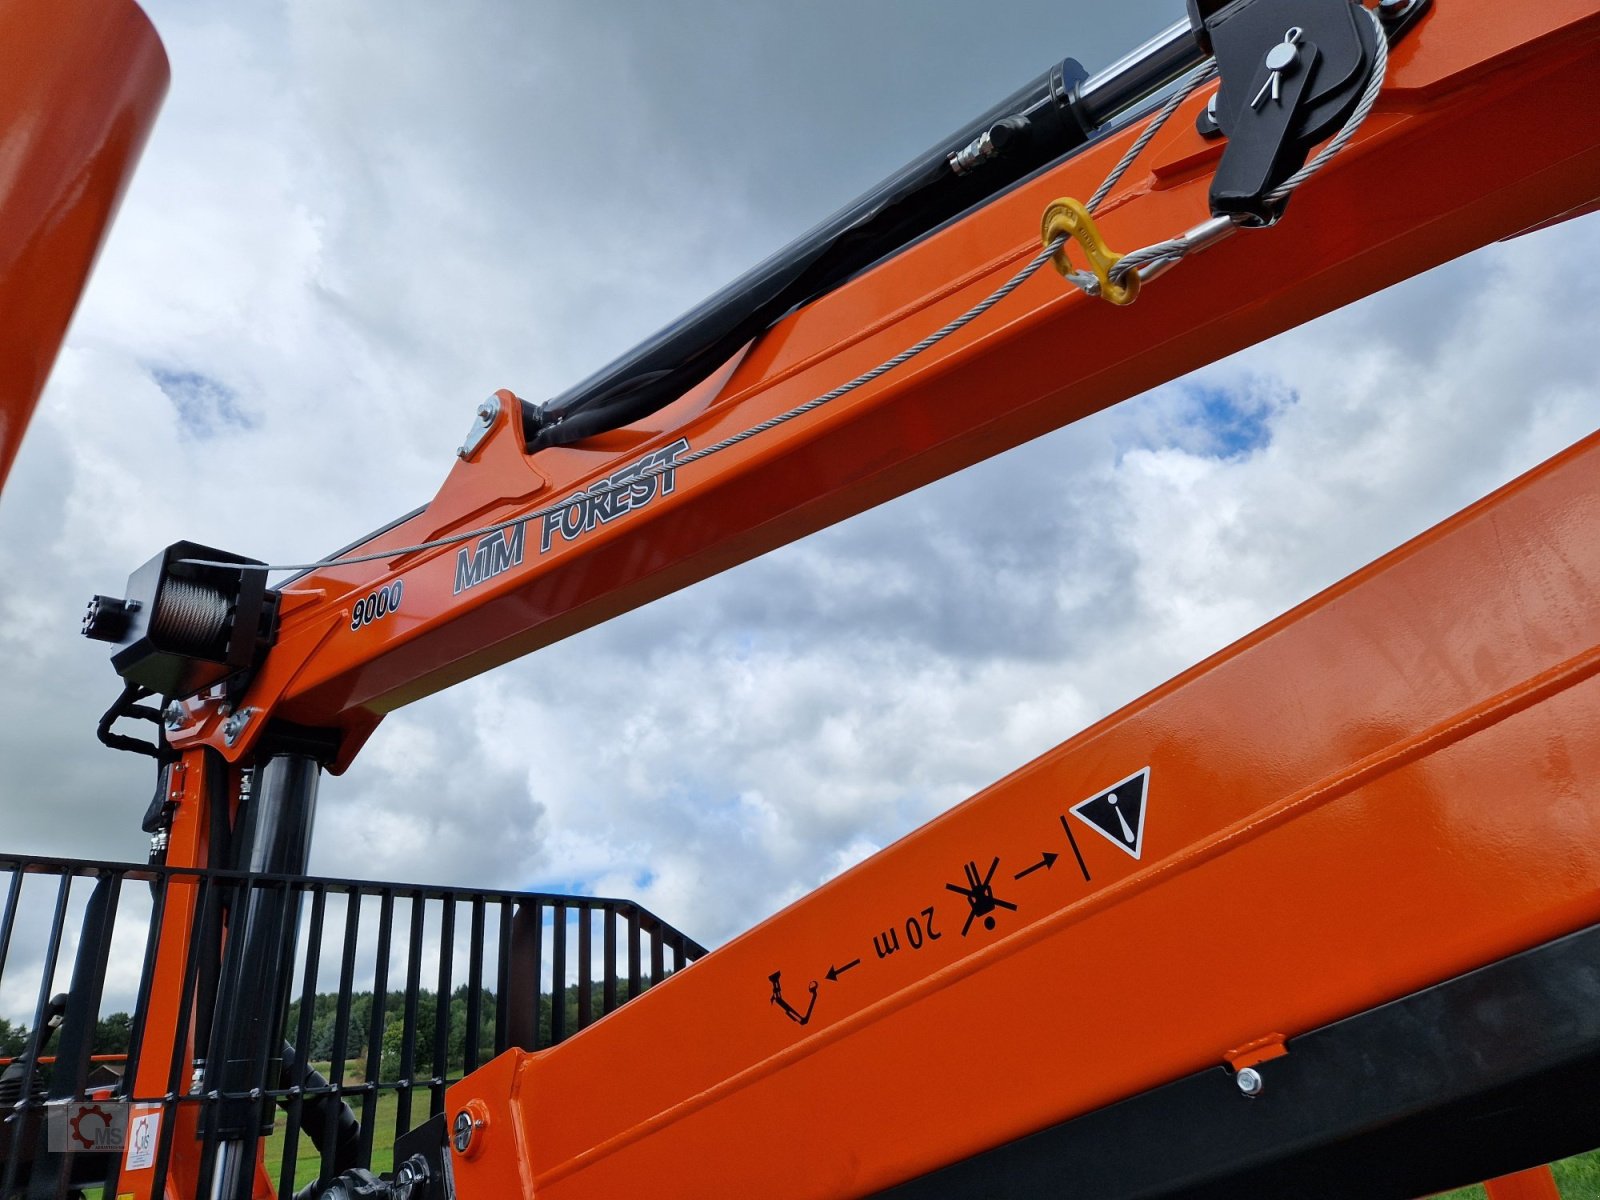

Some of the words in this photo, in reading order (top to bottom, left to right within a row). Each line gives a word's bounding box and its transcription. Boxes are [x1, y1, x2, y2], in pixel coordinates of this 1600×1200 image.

[453, 521, 526, 596] MTM
[540, 437, 690, 553] FOREST
[351, 579, 403, 632] 9000
[873, 928, 900, 959] m
[905, 906, 942, 949] 20
